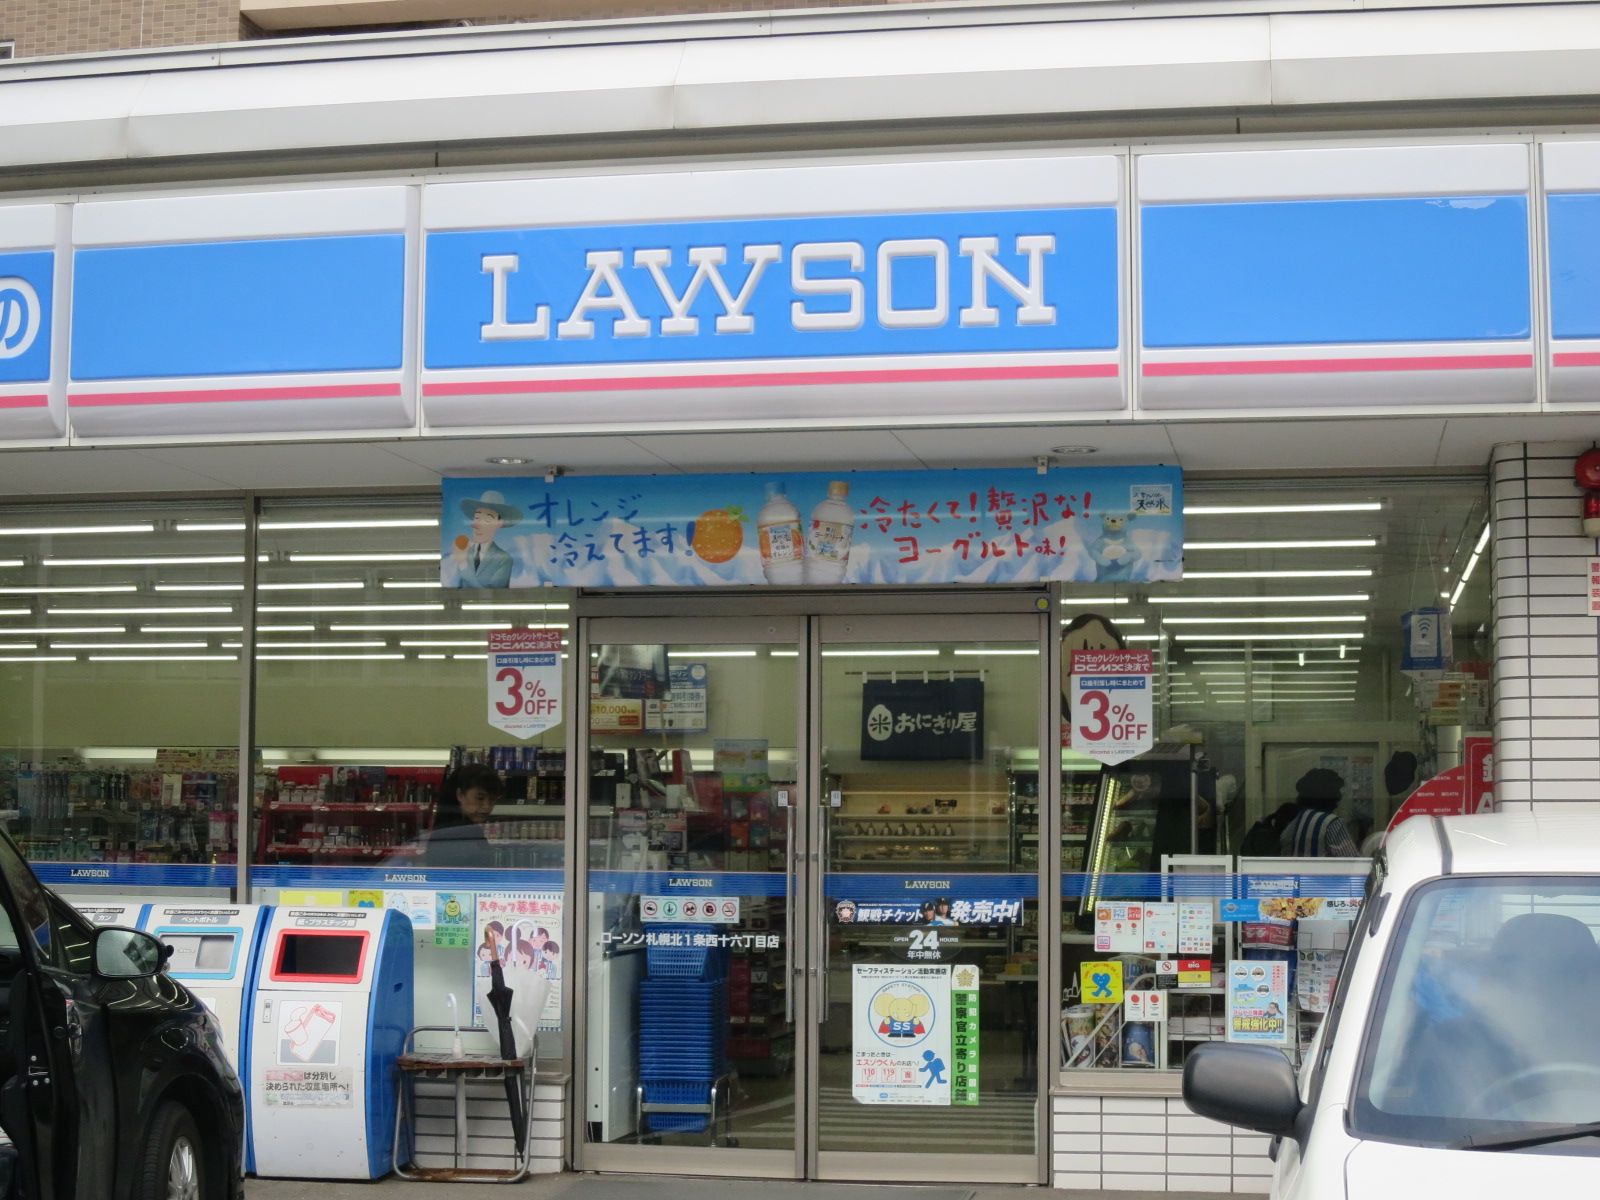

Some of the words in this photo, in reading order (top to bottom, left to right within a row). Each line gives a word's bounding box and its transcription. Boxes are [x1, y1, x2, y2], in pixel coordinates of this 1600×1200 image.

[480, 233, 1057, 342] LAWSON
[528, 492, 643, 529] オレンジ
[549, 520, 696, 568] 冷えてます!
[893, 531, 1067, 564] ヨーグルト味!
[524, 699, 558, 716] OFF
[895, 711, 977, 735] おにぎり屋
[1111, 724, 1148, 741] OFF
[70, 869, 110, 877] LAWSON
[384, 874, 427, 882] LAWSON
[668, 878, 712, 887] LAWSON
[904, 880, 951, 889] LAWSON
[950, 900, 1019, 924] 発売中!
[909, 930, 939, 950] 24
[907, 950, 942, 960] 年中無休
[893, 1022, 911, 1031] SS
